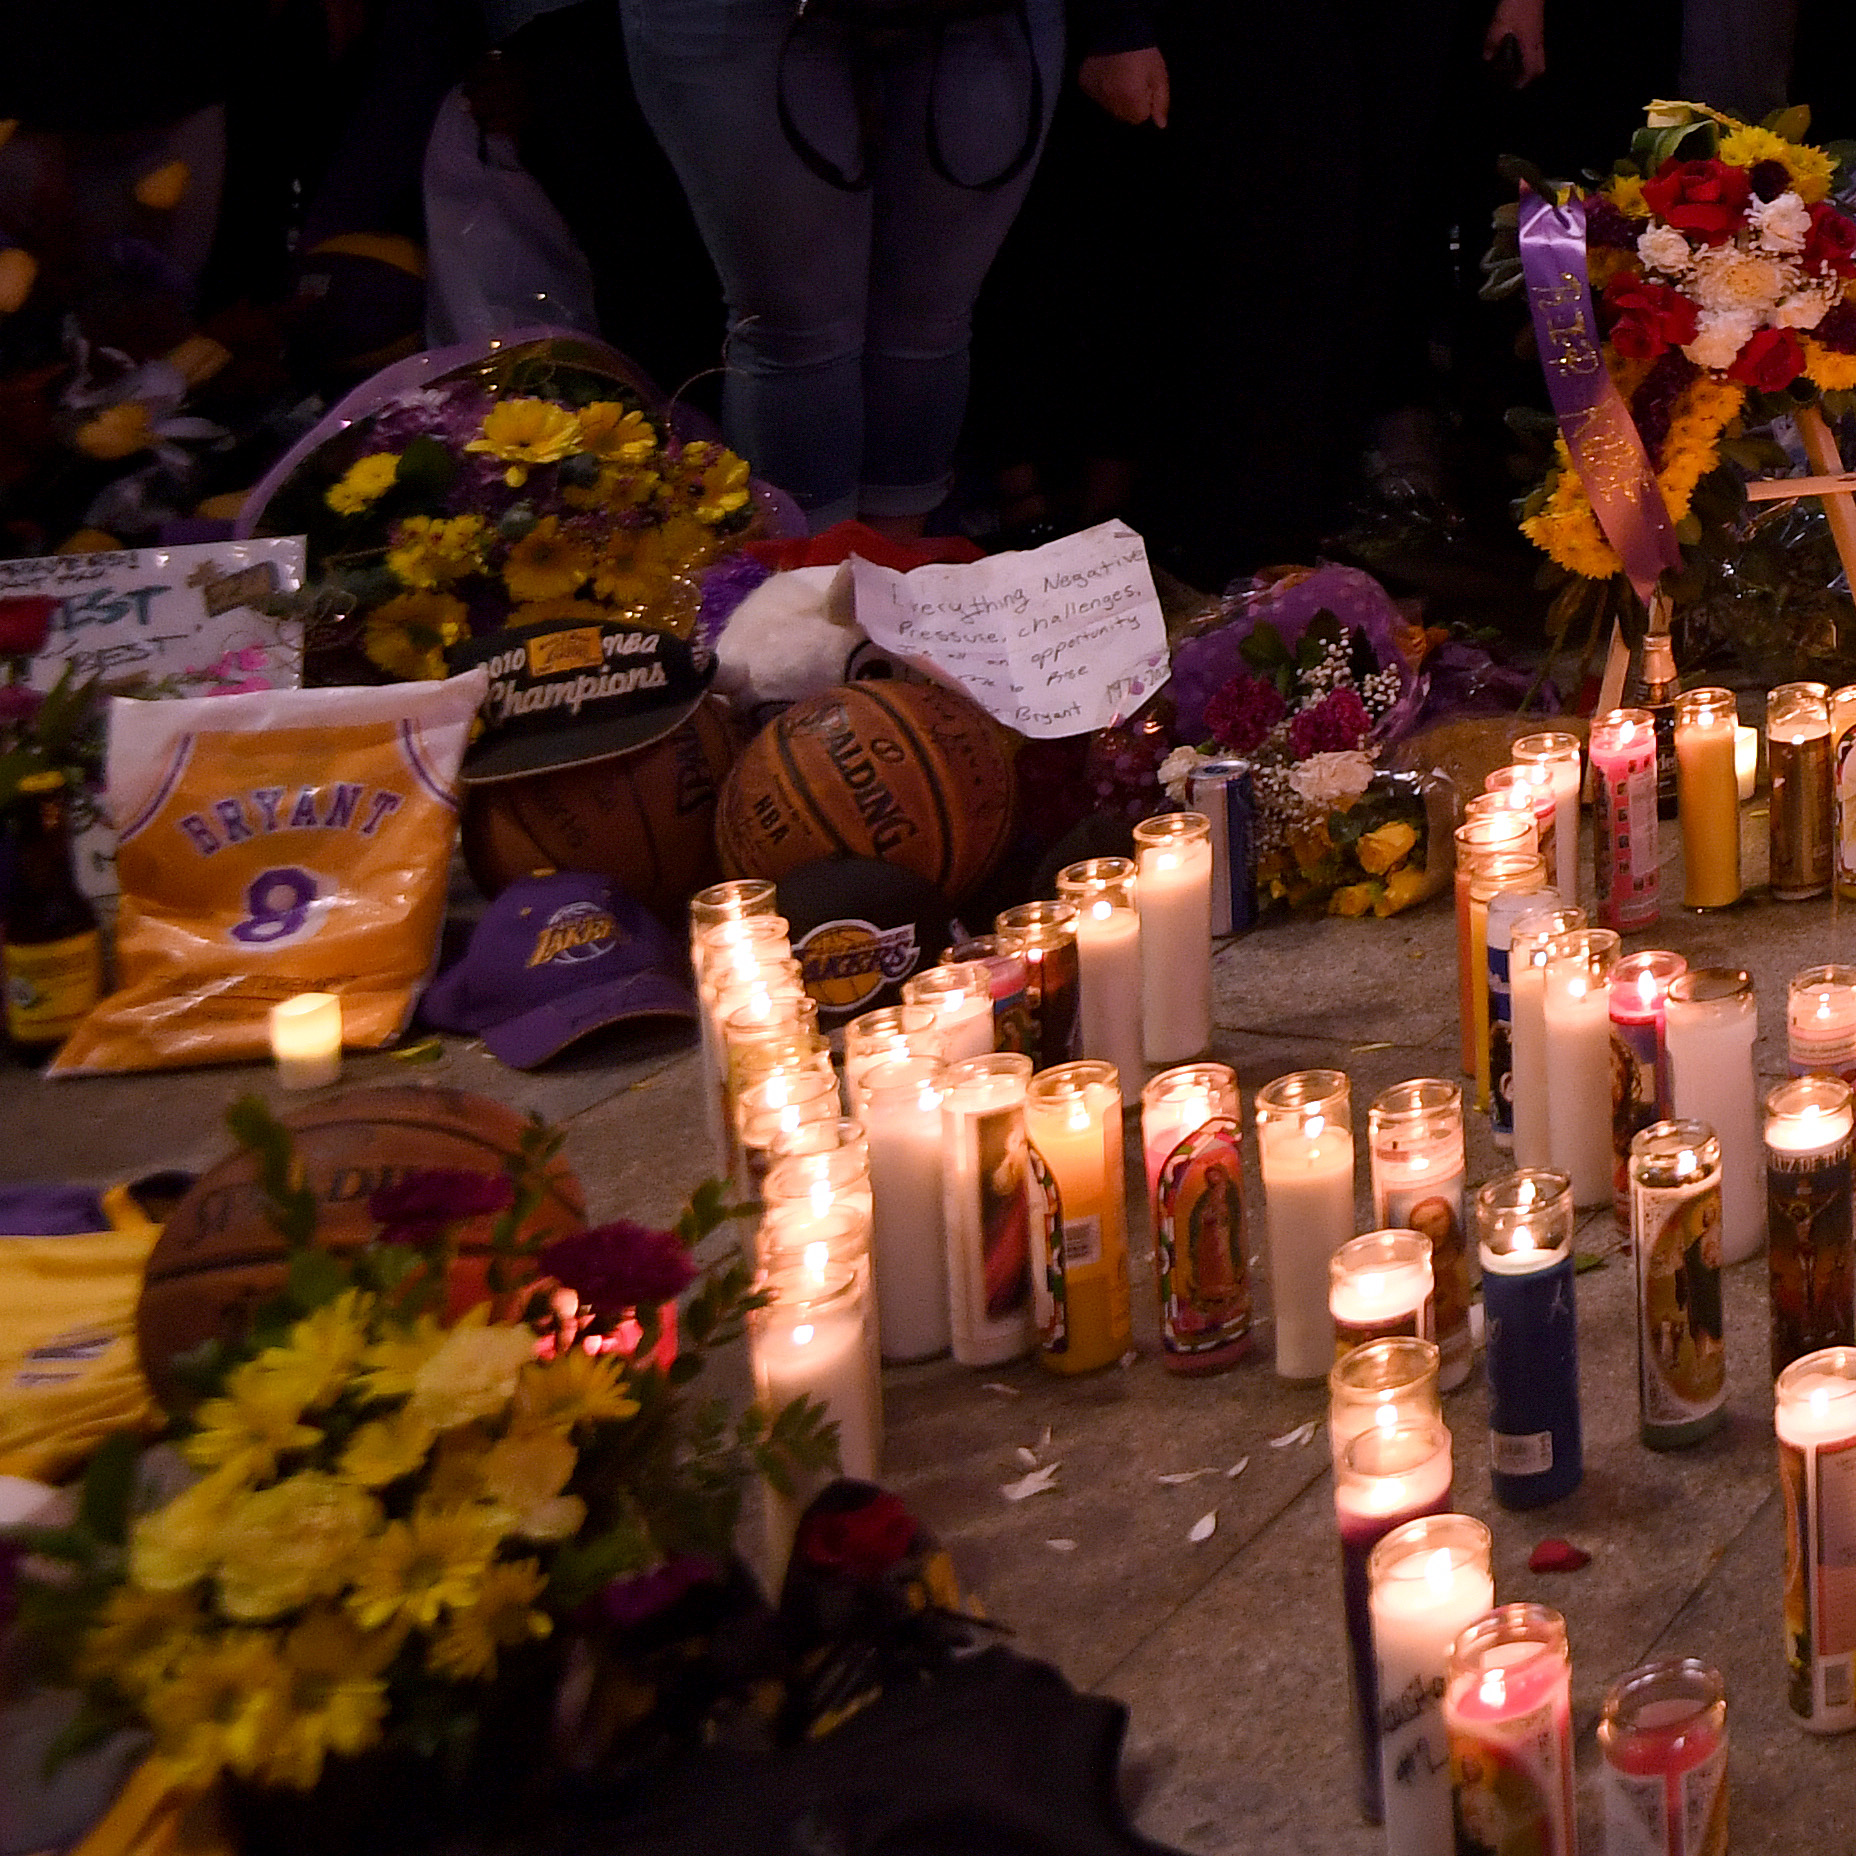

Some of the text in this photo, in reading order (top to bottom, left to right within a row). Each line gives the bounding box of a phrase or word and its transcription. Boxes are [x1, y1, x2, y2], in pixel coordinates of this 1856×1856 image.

[1043, 548, 1146, 593] Negative
[62, 584, 173, 631] EST
[486, 661, 670, 721] Champions
[180, 781, 403, 857] BRYANT
